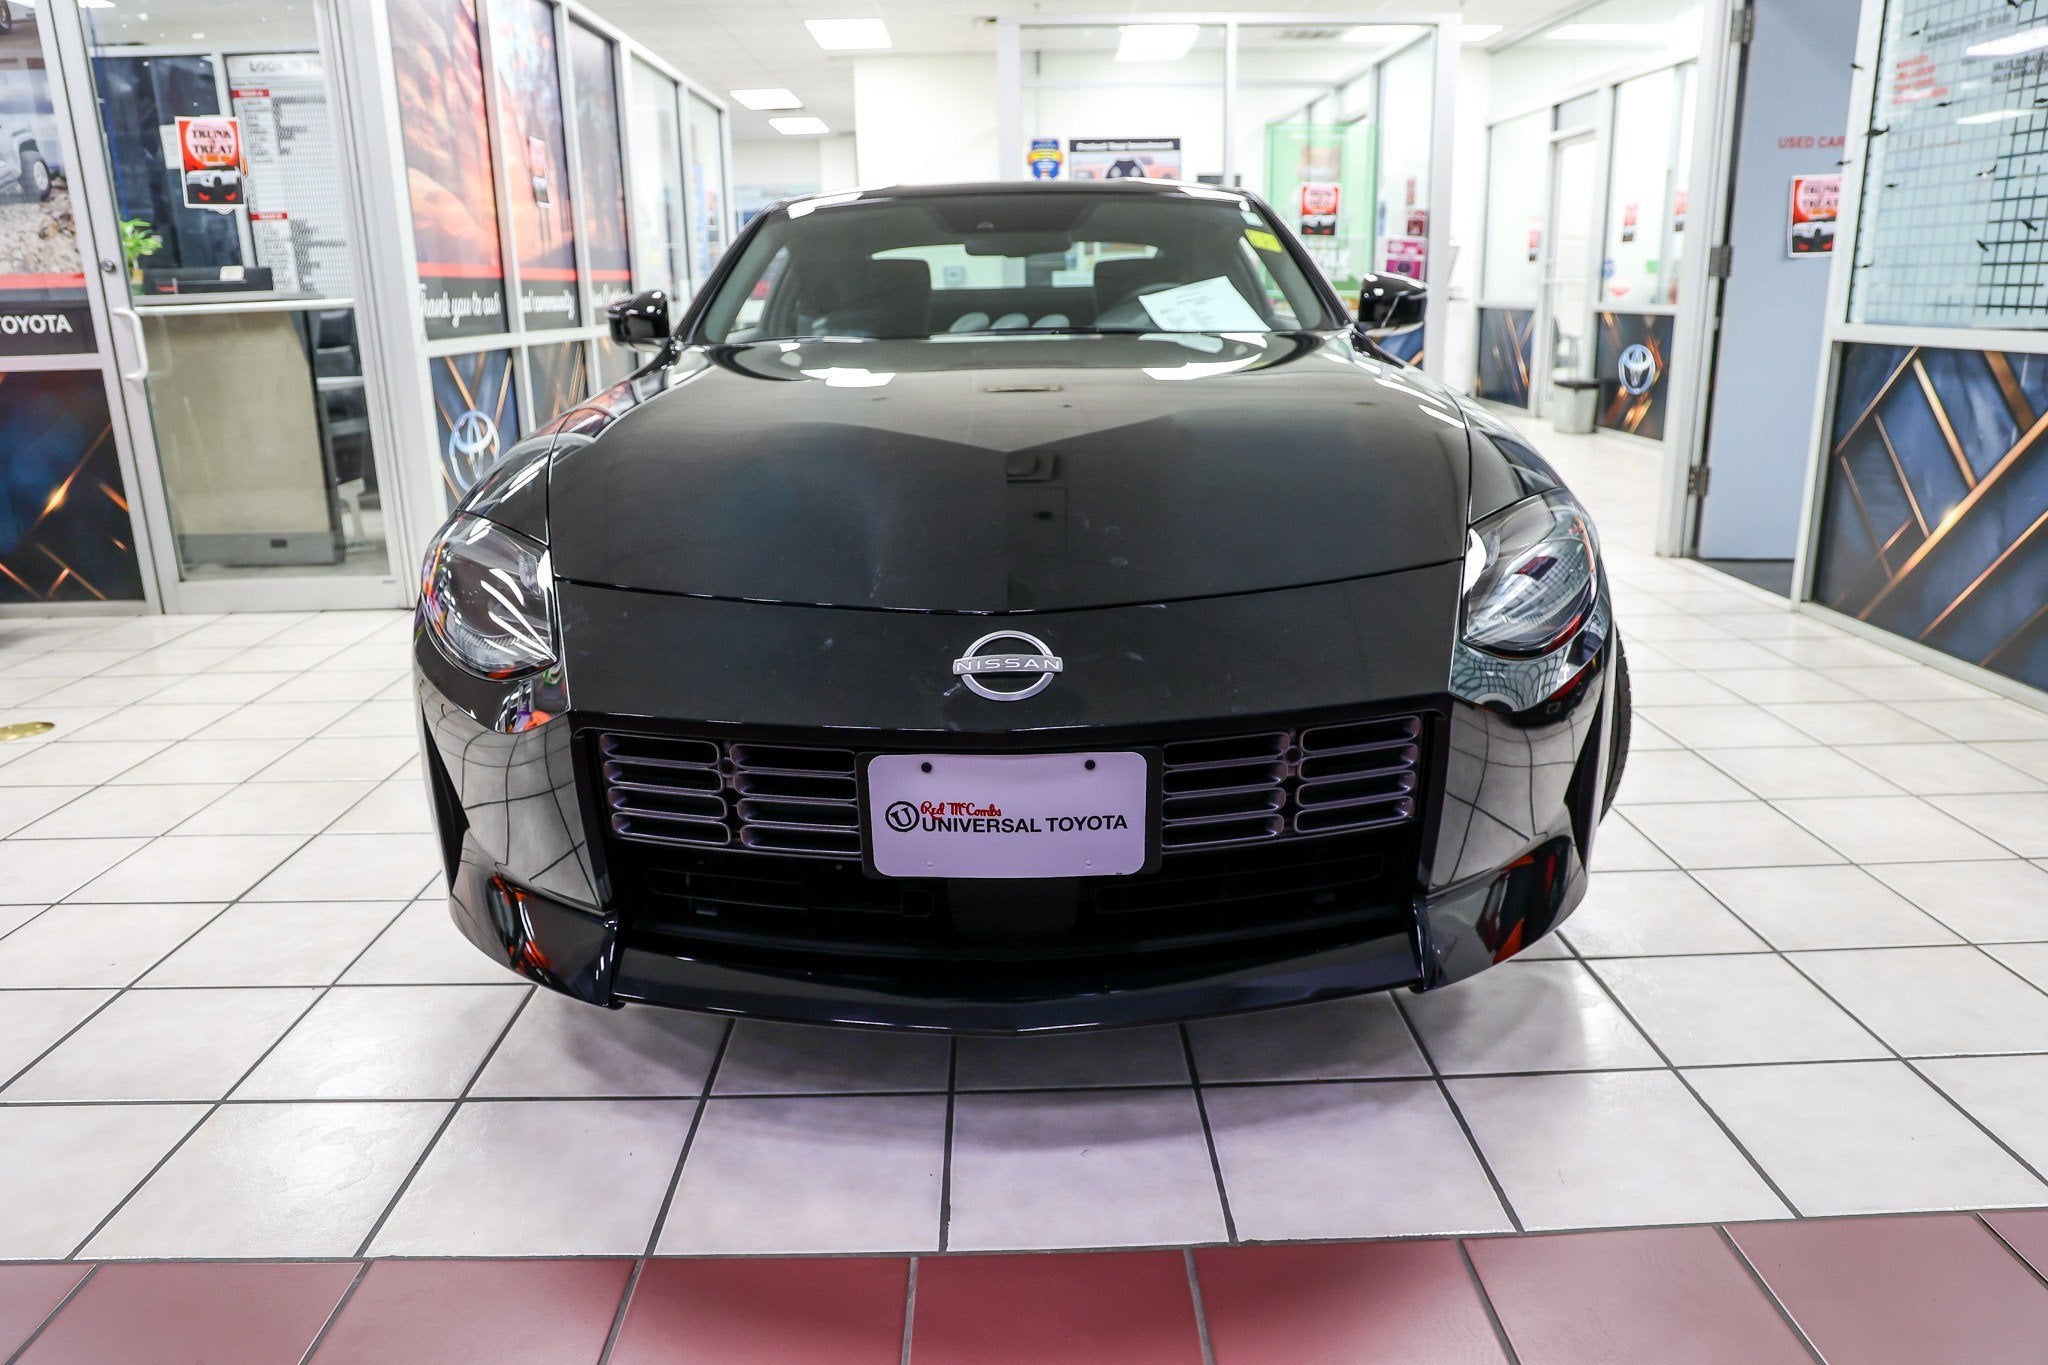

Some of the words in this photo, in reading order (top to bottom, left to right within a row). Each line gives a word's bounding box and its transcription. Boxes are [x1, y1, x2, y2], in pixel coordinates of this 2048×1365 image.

[192, 130, 231, 139] TRUNK
[1778, 135, 1815, 149] USED
[1817, 135, 1845, 148] CAR
[194, 145, 232, 154] TREAT
[451, 297, 472, 328] you
[0, 314, 73, 334] OYOTA
[956, 658, 1060, 672] NISSAN
[921, 800, 946, 820] Red
[947, 802, 1002, 817] McCombs
[921, 816, 1042, 834] UNIVERSAL
[1046, 814, 1128, 832] TOYOTA
